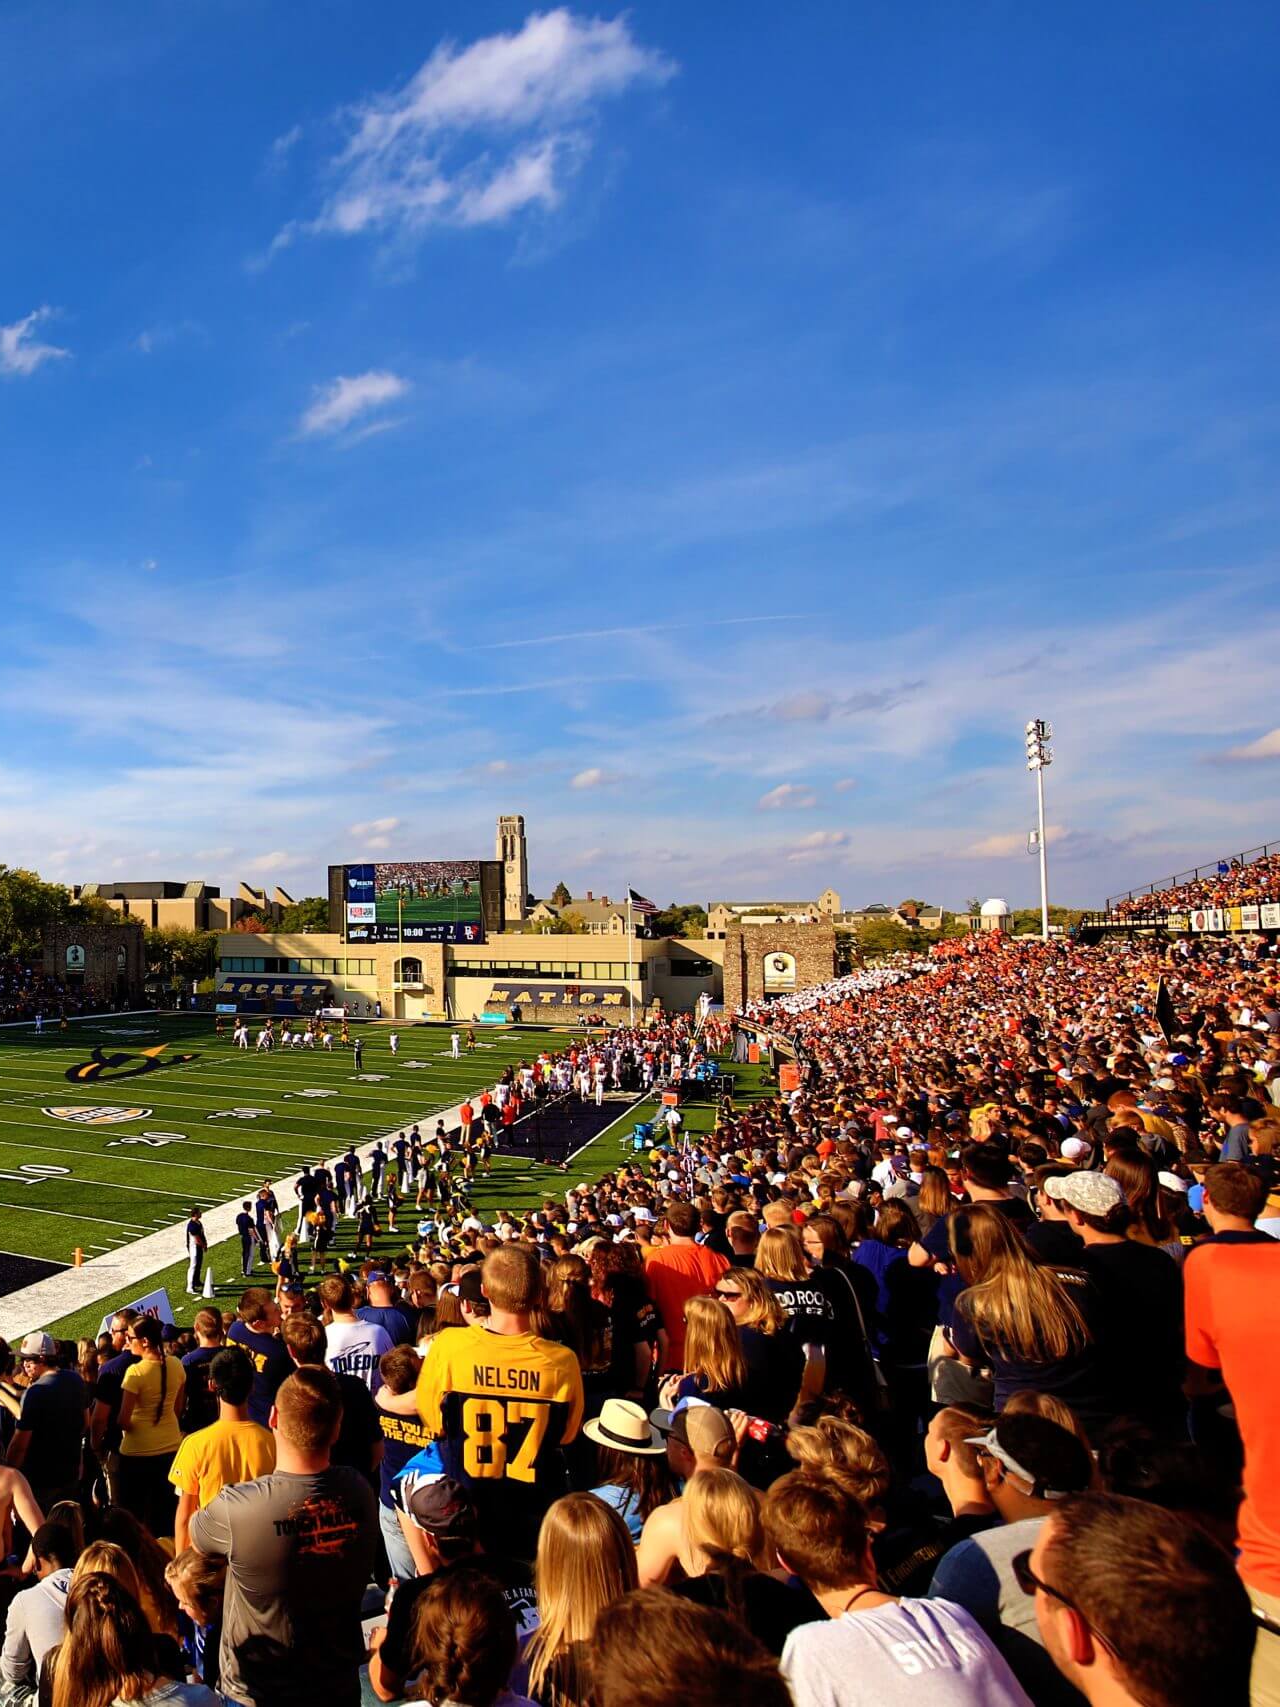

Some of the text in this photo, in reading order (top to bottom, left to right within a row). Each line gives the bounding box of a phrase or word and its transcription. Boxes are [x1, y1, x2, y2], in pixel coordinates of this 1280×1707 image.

[403, 928, 423, 937] 10:00
[220, 983, 327, 995] ROCKET
[490, 990, 623, 1005] NATION
[120, 1131, 188, 1147] 20
[330, 1353, 381, 1373] TOLEDO
[473, 1364, 540, 1392] NELSON
[379, 1415, 399, 1430] SEE
[400, 1420, 420, 1436] YOU
[382, 1426, 403, 1441] THE
[463, 1398, 551, 1483] 87
